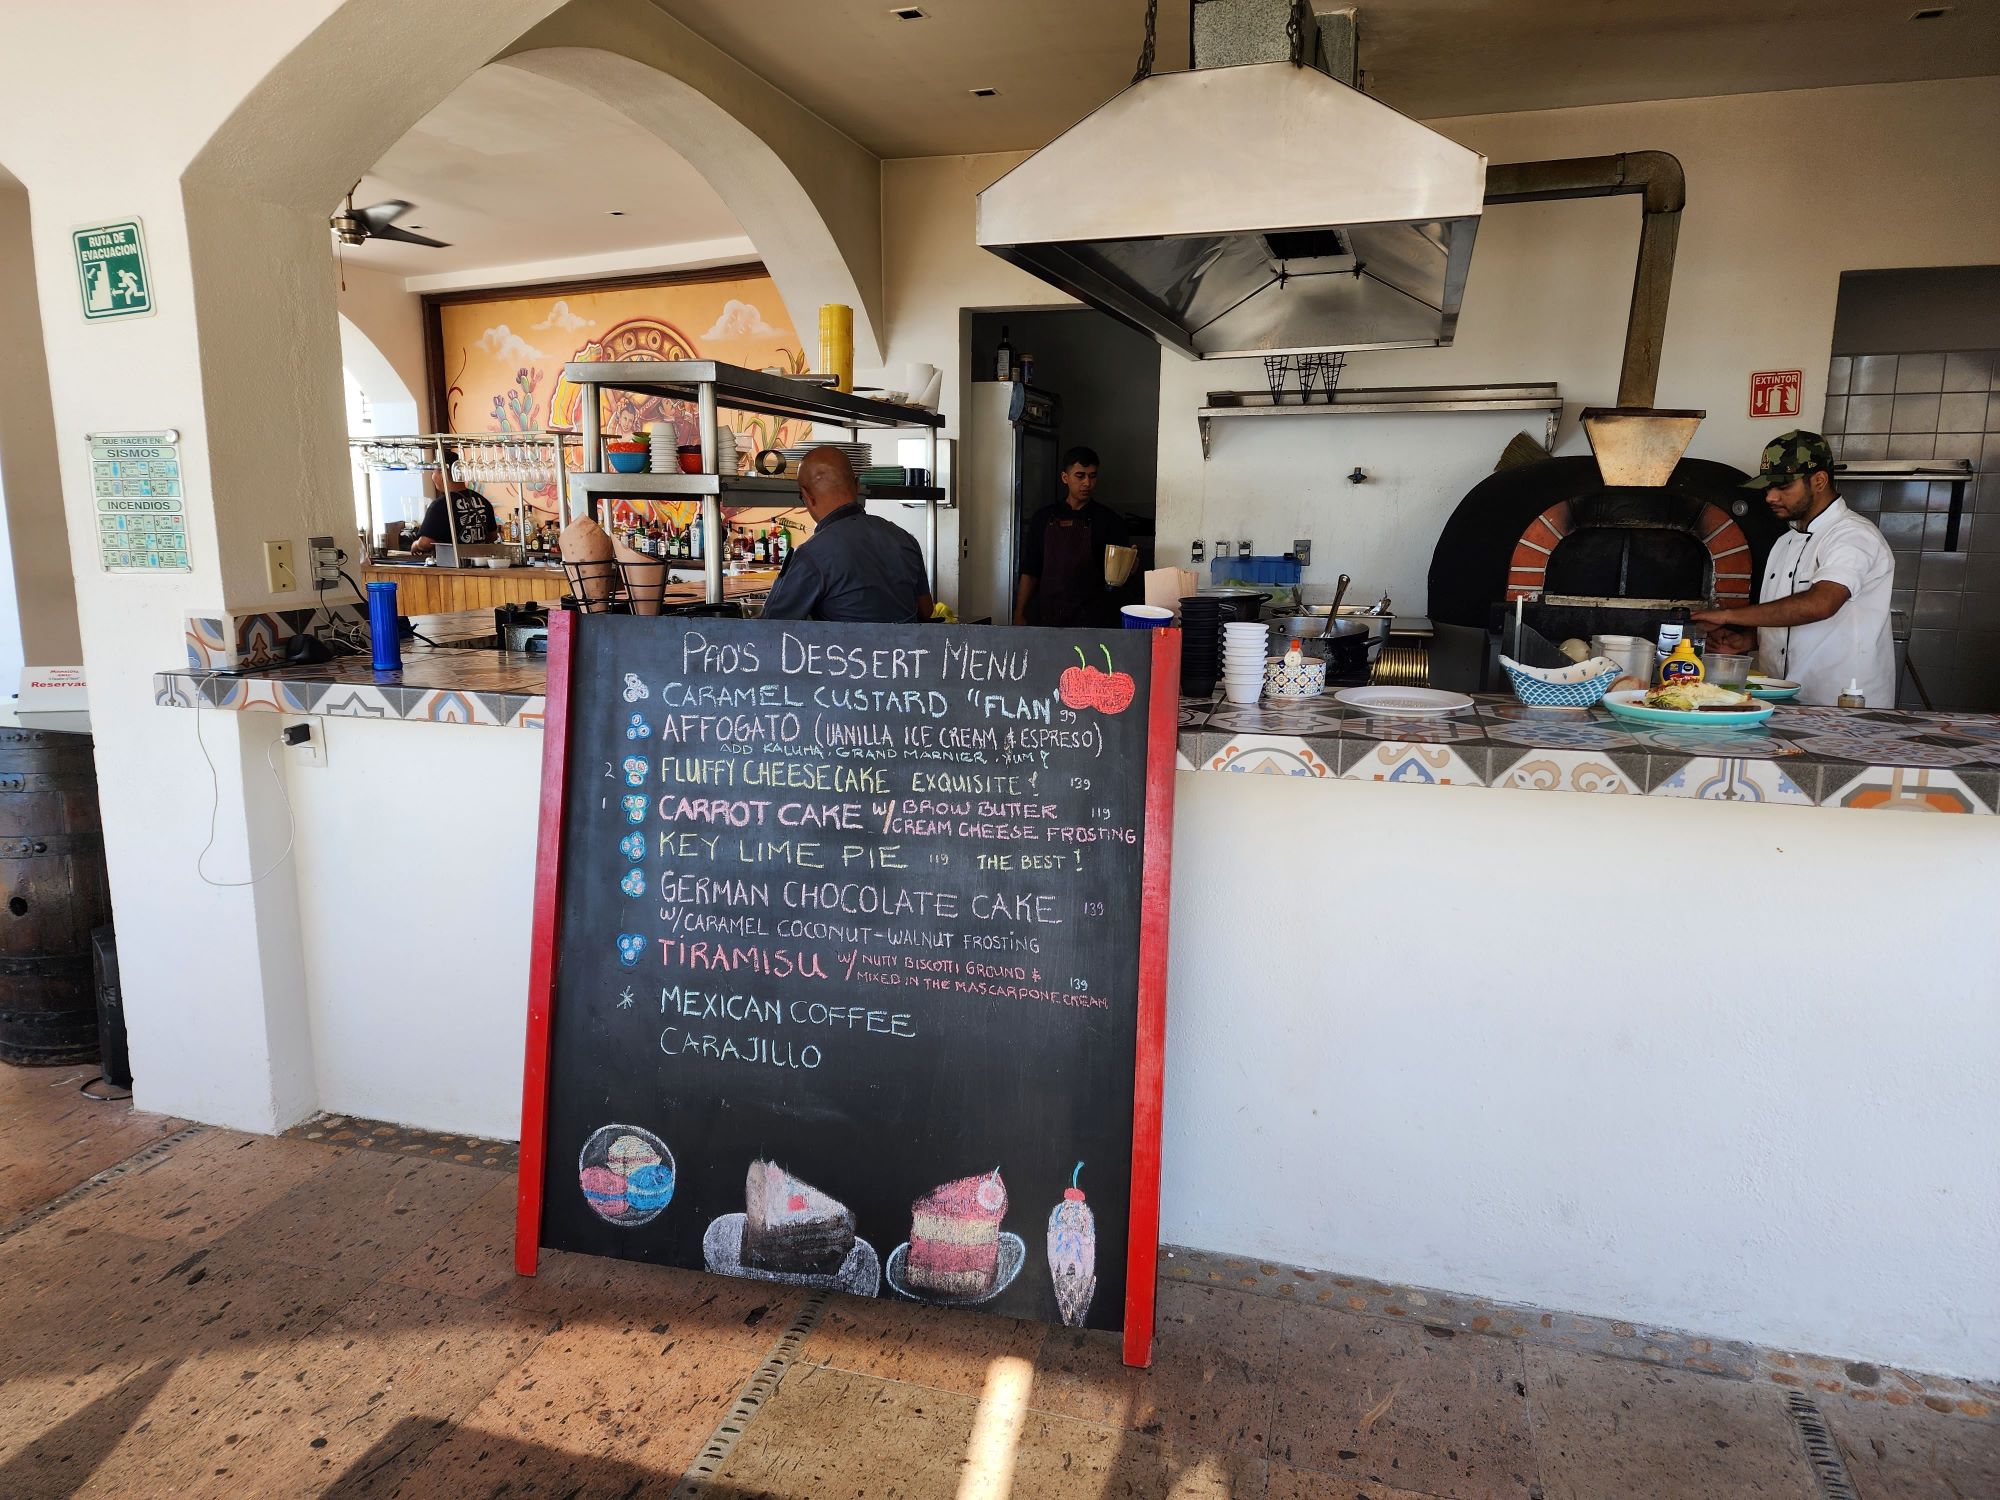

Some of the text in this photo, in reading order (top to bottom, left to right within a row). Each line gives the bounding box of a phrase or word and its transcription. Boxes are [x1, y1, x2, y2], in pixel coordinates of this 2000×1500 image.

[81, 243, 137, 262] EVACUACION
[88, 231, 126, 248] RUTA DE
[1755, 374, 1798, 385] EXTINTOR
[107, 449, 160, 458] SISMOS
[107, 501, 170, 510] INCENDIOS
[781, 632, 929, 680] DESSERT
[942, 637, 1029, 681] MENU
[662, 682, 804, 708] CARAMEL
[813, 685, 948, 718] CUSTARD
[1059, 709, 1077, 725] 99
[662, 711, 800, 743] AFFOGATO
[904, 724, 933, 749] ICE
[939, 726, 997, 751] CREAM
[1020, 721, 1103, 758] ESPRESO)
[719, 743, 754, 755] ADD
[835, 746, 898, 761] GRAND
[604, 762, 616, 779] 2
[660, 756, 737, 786] FLUFFY
[911, 771, 1022, 796] EXQUISITE
[1070, 777, 1091, 791] 139
[658, 794, 773, 827] CARROT
[777, 802, 864, 831] CAKE
[901, 799, 972, 816] BROW
[977, 801, 1058, 819] BUTTER
[1090, 807, 1112, 820] 119
[892, 817, 1137, 845] CREAM CHEESE FROSTING
[659, 831, 720, 861] KEY
[739, 838, 825, 869] LIME
[841, 845, 909, 870] PIE
[929, 853, 950, 866] 119
[976, 854, 1014, 871] THE
[1020, 855, 1067, 871] BEST
[660, 870, 1105, 924] GERMAN CHOCOLATE CAKE 139
[965, 960, 1026, 981] GROUND
[856, 970, 1109, 1010] MIXED IN THE MASCARPONE CREAM 139
[659, 984, 916, 1038] MEXICAN COFFEE
[660, 1027, 822, 1069] CARAJILLO
